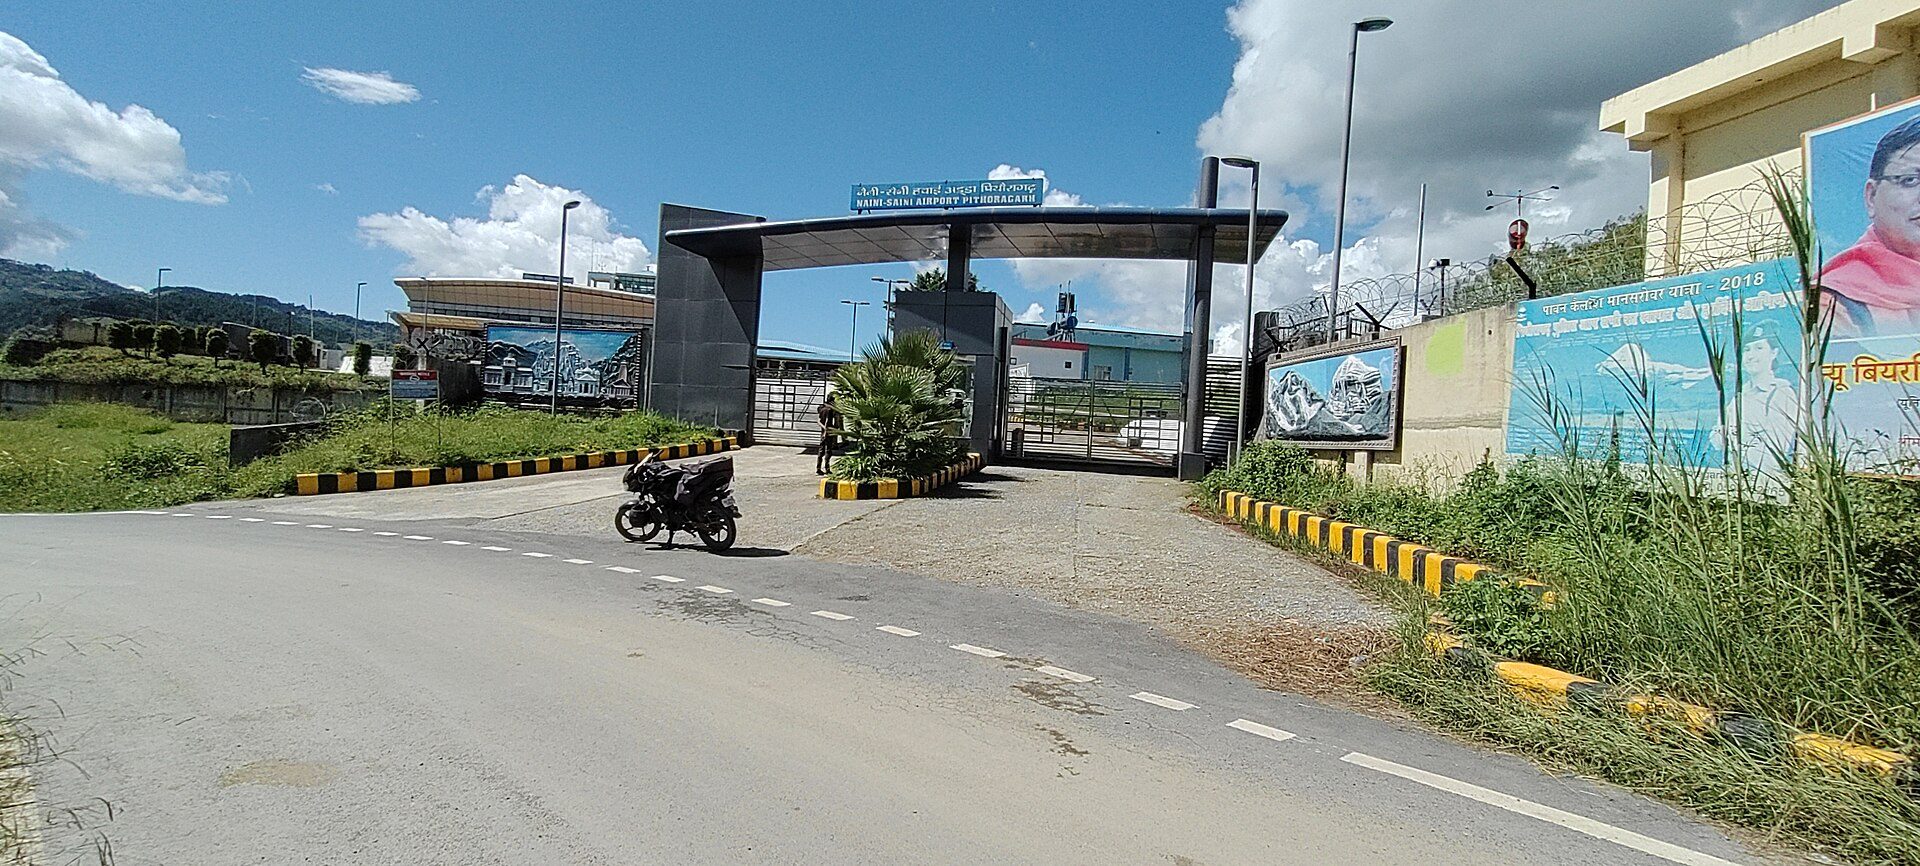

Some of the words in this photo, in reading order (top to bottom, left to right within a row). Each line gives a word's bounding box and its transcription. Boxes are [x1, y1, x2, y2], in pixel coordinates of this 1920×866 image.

[856, 197, 913, 207] NAINI-SAINI
[916, 196, 959, 206] AIRPORT
[962, 194, 1036, 204] PITHORAGARH
[1543, 304, 1566, 315] पावन
[1607, 288, 1664, 307] मानसरोवर
[1668, 282, 1702, 298] यात्रा
[1720, 272, 1764, 290] 2018
[1852, 354, 1920, 384] बियर
